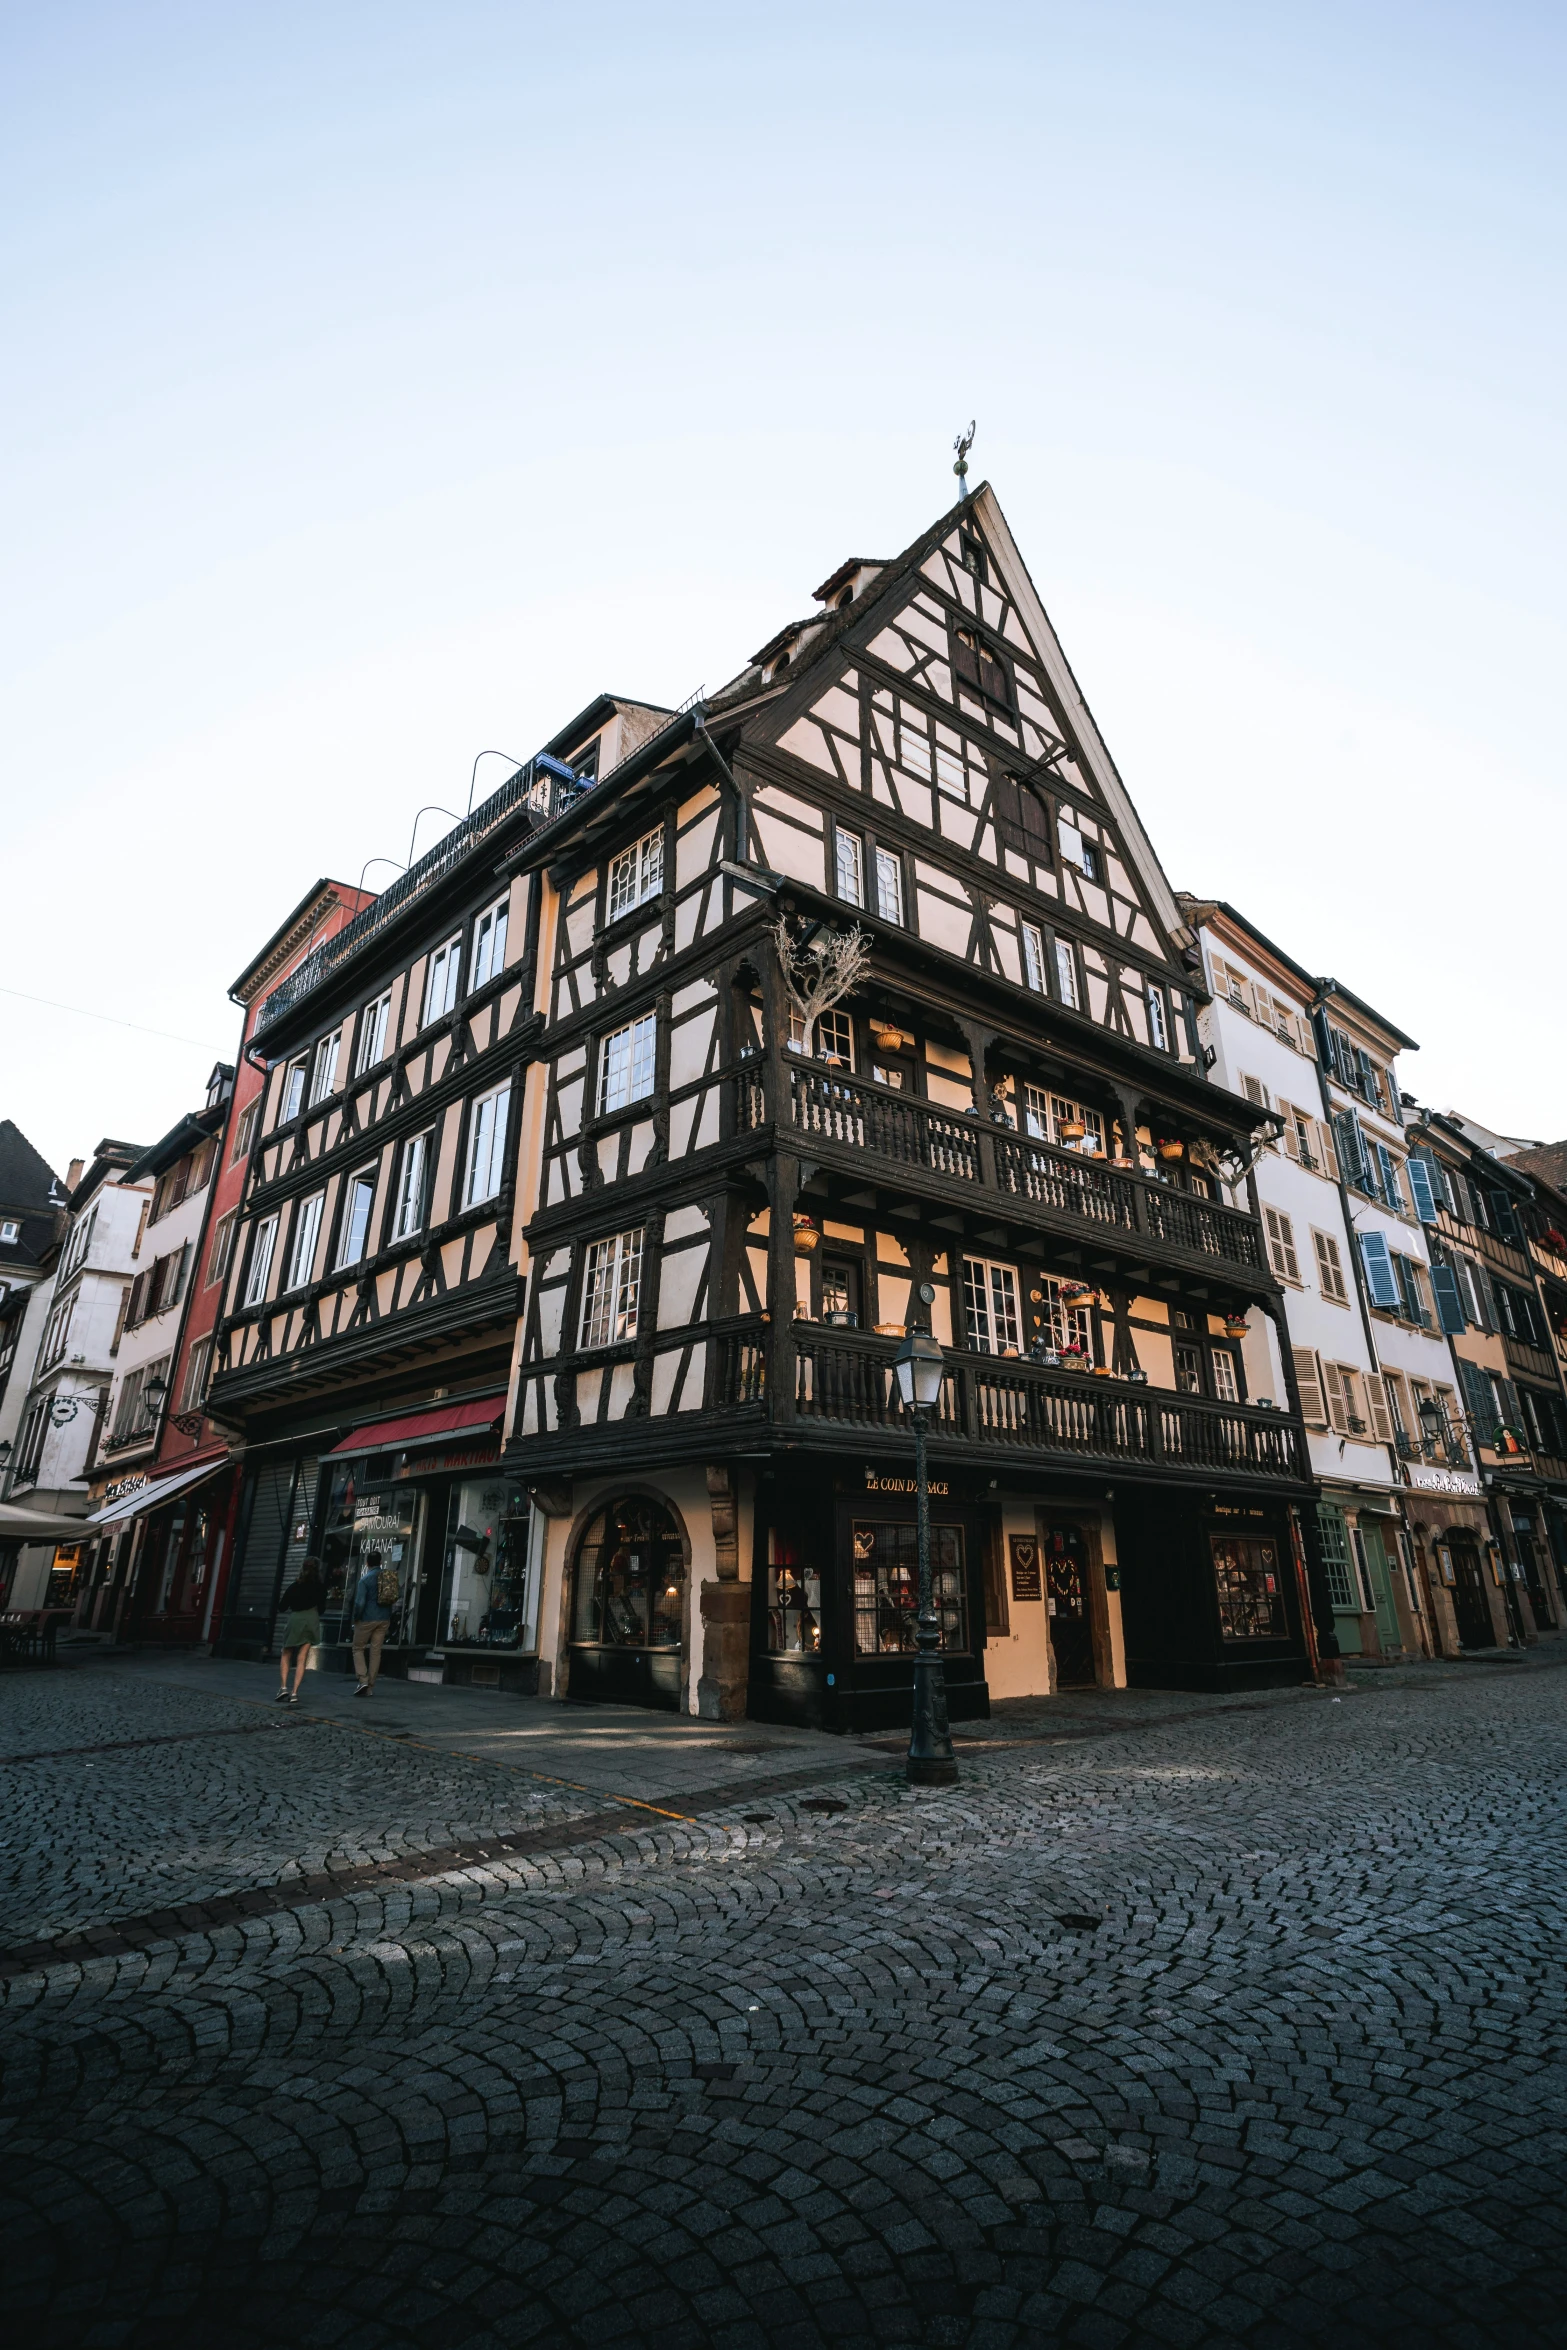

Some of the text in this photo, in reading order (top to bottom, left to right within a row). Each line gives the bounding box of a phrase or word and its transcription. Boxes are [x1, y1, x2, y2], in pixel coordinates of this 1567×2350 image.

[866, 1477, 949, 1495] LE COIN D'SACE
